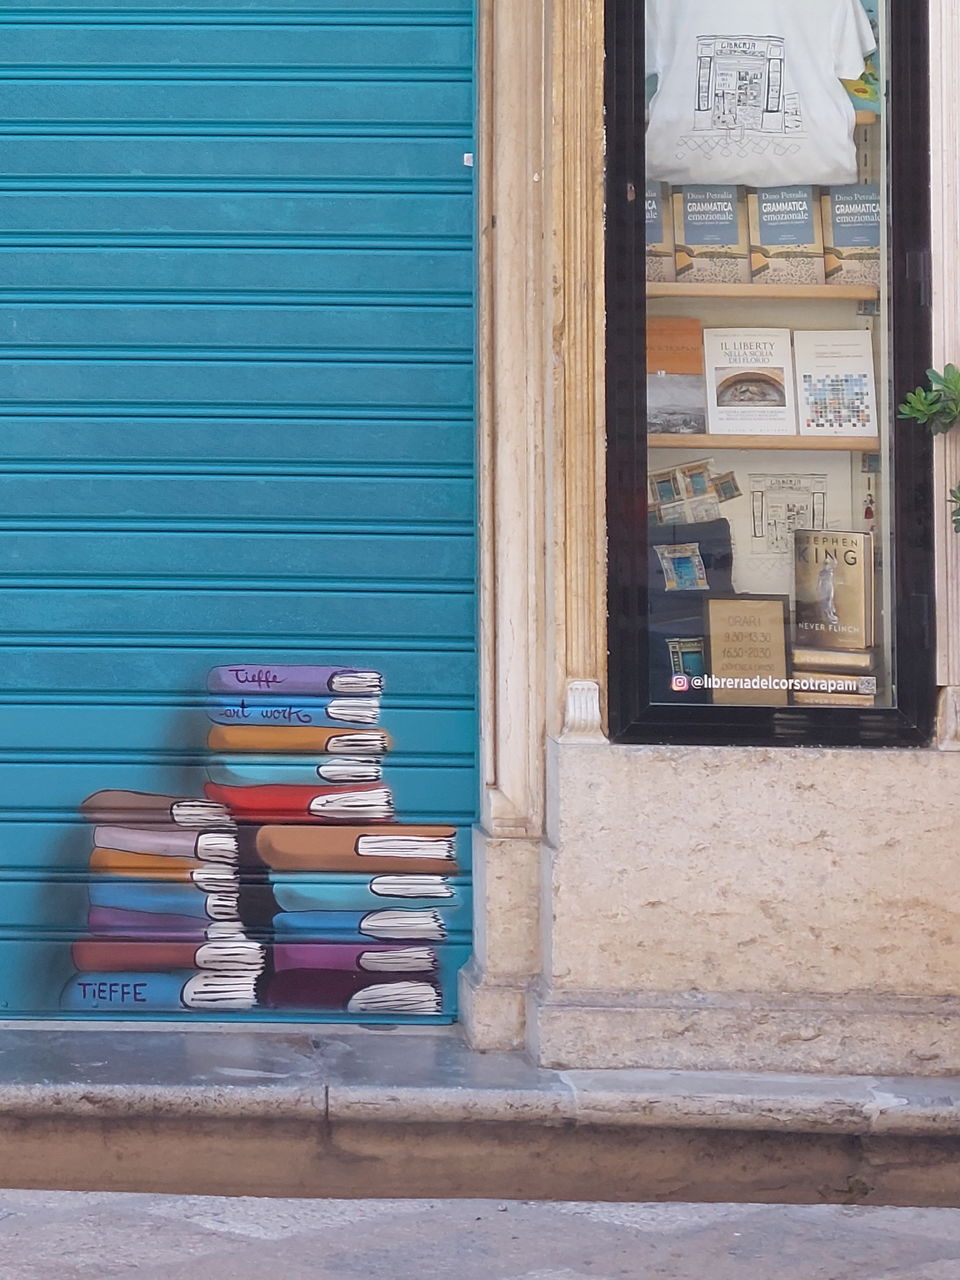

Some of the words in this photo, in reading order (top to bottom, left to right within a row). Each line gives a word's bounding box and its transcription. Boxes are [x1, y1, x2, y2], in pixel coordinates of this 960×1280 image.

[687, 192, 705, 200] Dino
[706, 191, 733, 199] Petralia
[762, 192, 780, 200] Dino
[781, 191, 808, 199] Petralia
[835, 193, 853, 201] Dino
[687, 202, 733, 212] GRAMMATICA
[762, 201, 808, 212] GRAMMATICA
[835, 203, 880, 214] GRAMMATICA
[687, 211, 734, 221] emozionale
[762, 211, 809, 222] emozionale
[720, 341, 730, 351] IL
[733, 341, 776, 351] LIBERTY
[797, 546, 857, 566] KING
[798, 622, 825, 631] NEVER
[828, 624, 859, 633] FLINCH
[691, 674, 857, 693] @libreriadelcorsotrapani
